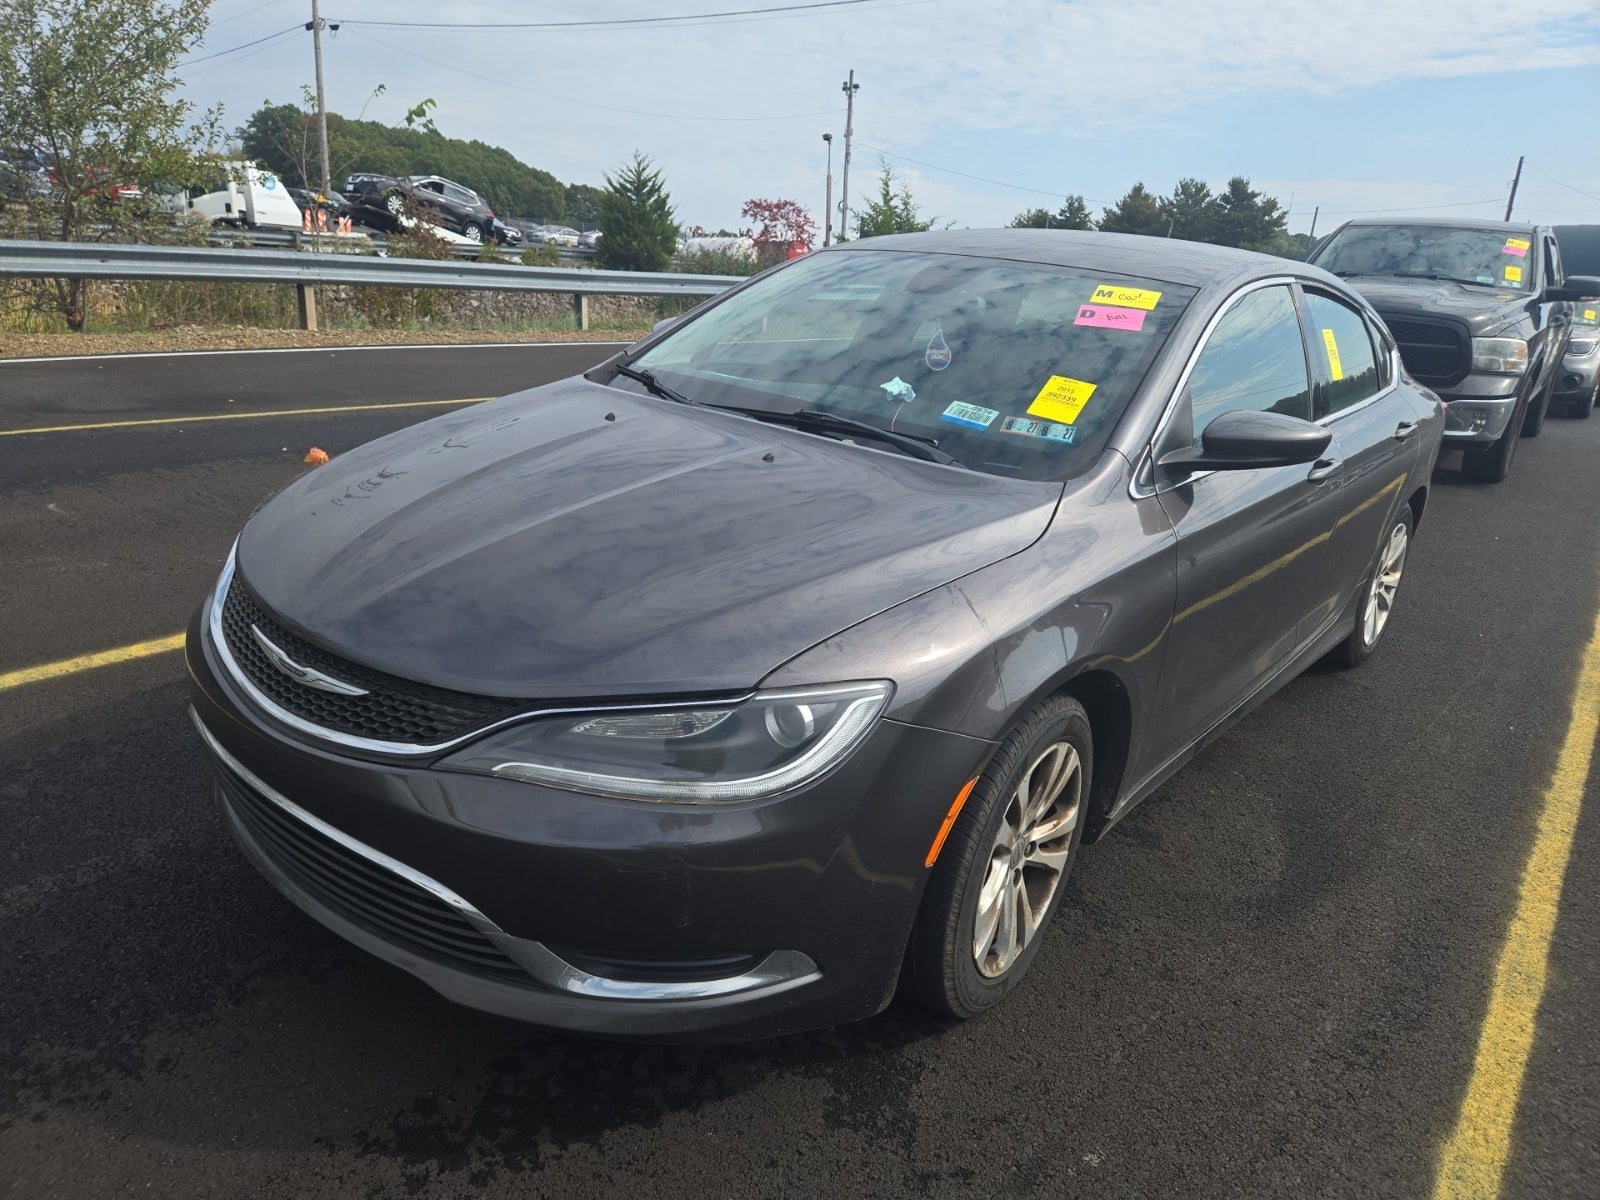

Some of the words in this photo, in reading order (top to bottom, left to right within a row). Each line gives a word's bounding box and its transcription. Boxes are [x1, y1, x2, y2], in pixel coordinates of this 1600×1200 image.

[1095, 289, 1114, 298] M
[1079, 309, 1096, 319] D
[1057, 386, 1075, 394] 2015
[1027, 421, 1038, 434] 27
[1062, 427, 1074, 440] 27
